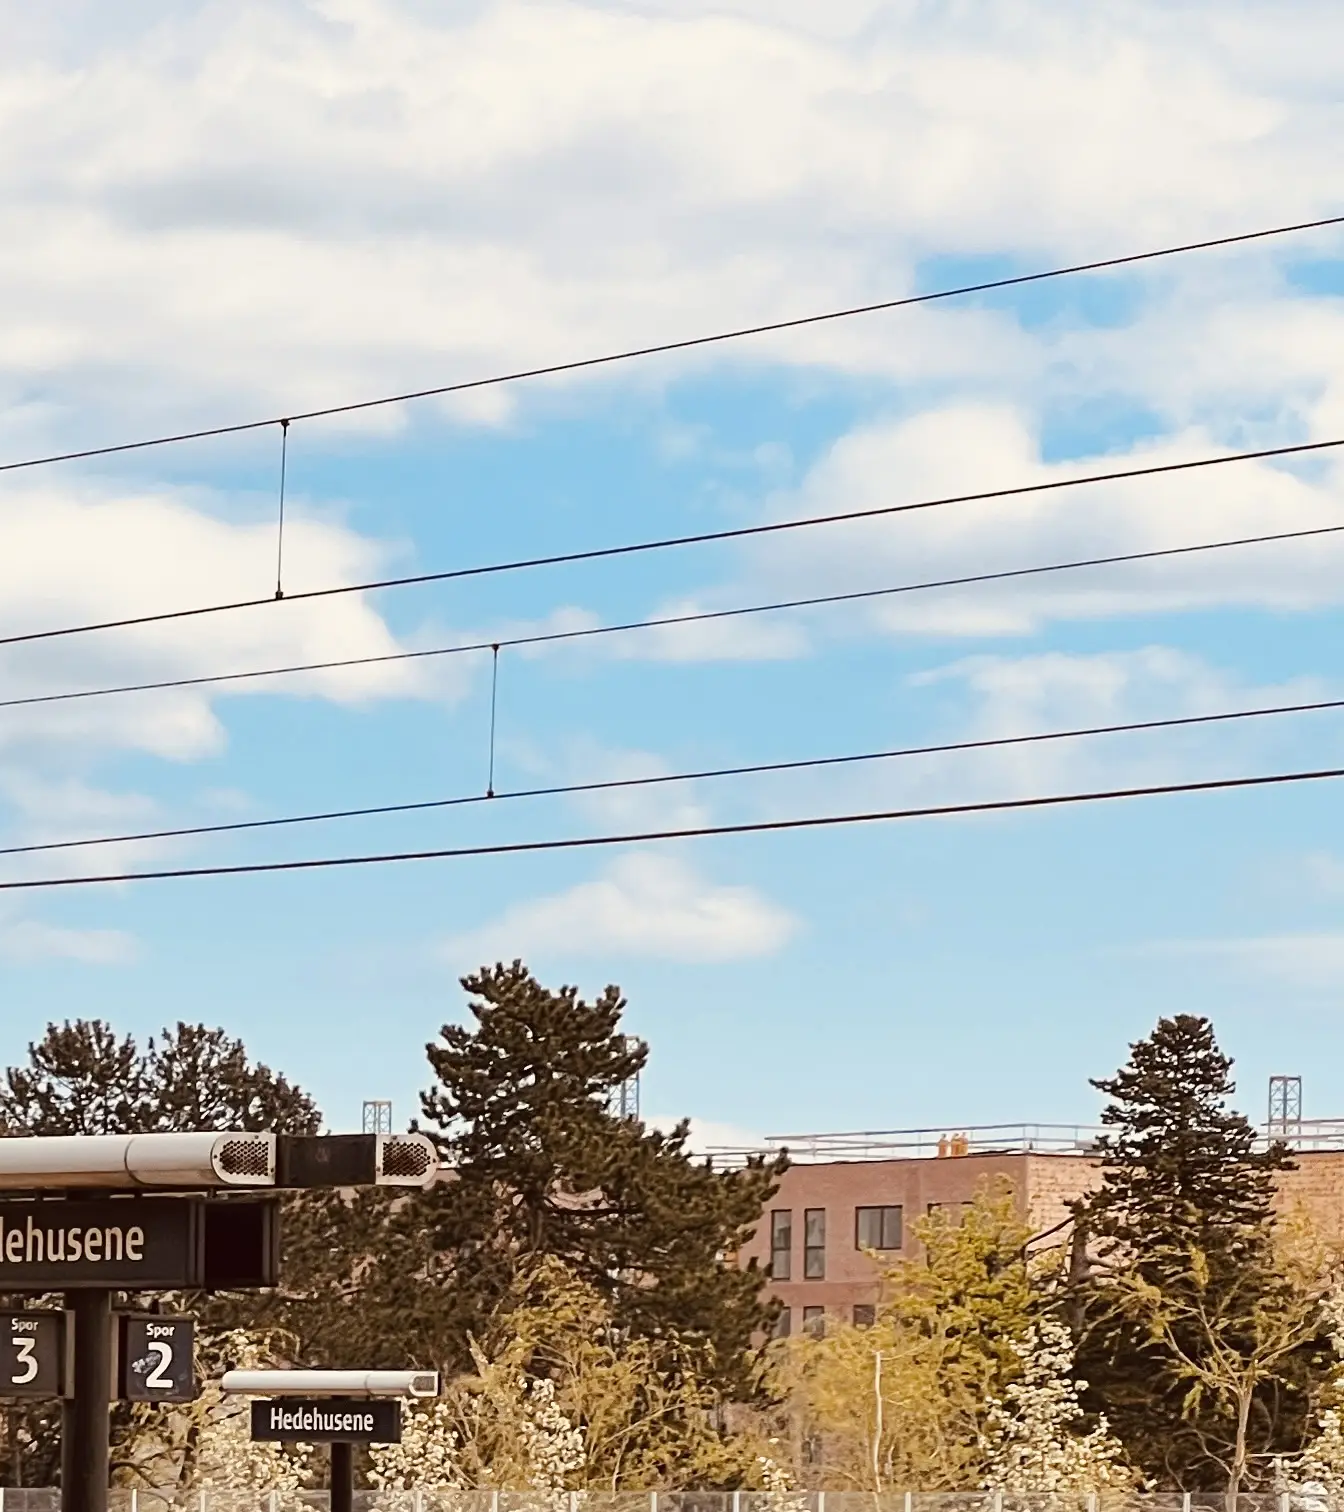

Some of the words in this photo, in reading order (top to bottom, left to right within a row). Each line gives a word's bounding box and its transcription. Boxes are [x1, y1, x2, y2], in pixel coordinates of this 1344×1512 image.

[10, 1317, 40, 1333] Spor
[145, 1322, 177, 1339] Spor
[10, 1337, 39, 1385] 3
[144, 1341, 175, 1389] 2
[269, 1406, 375, 1432] Hedehusene
